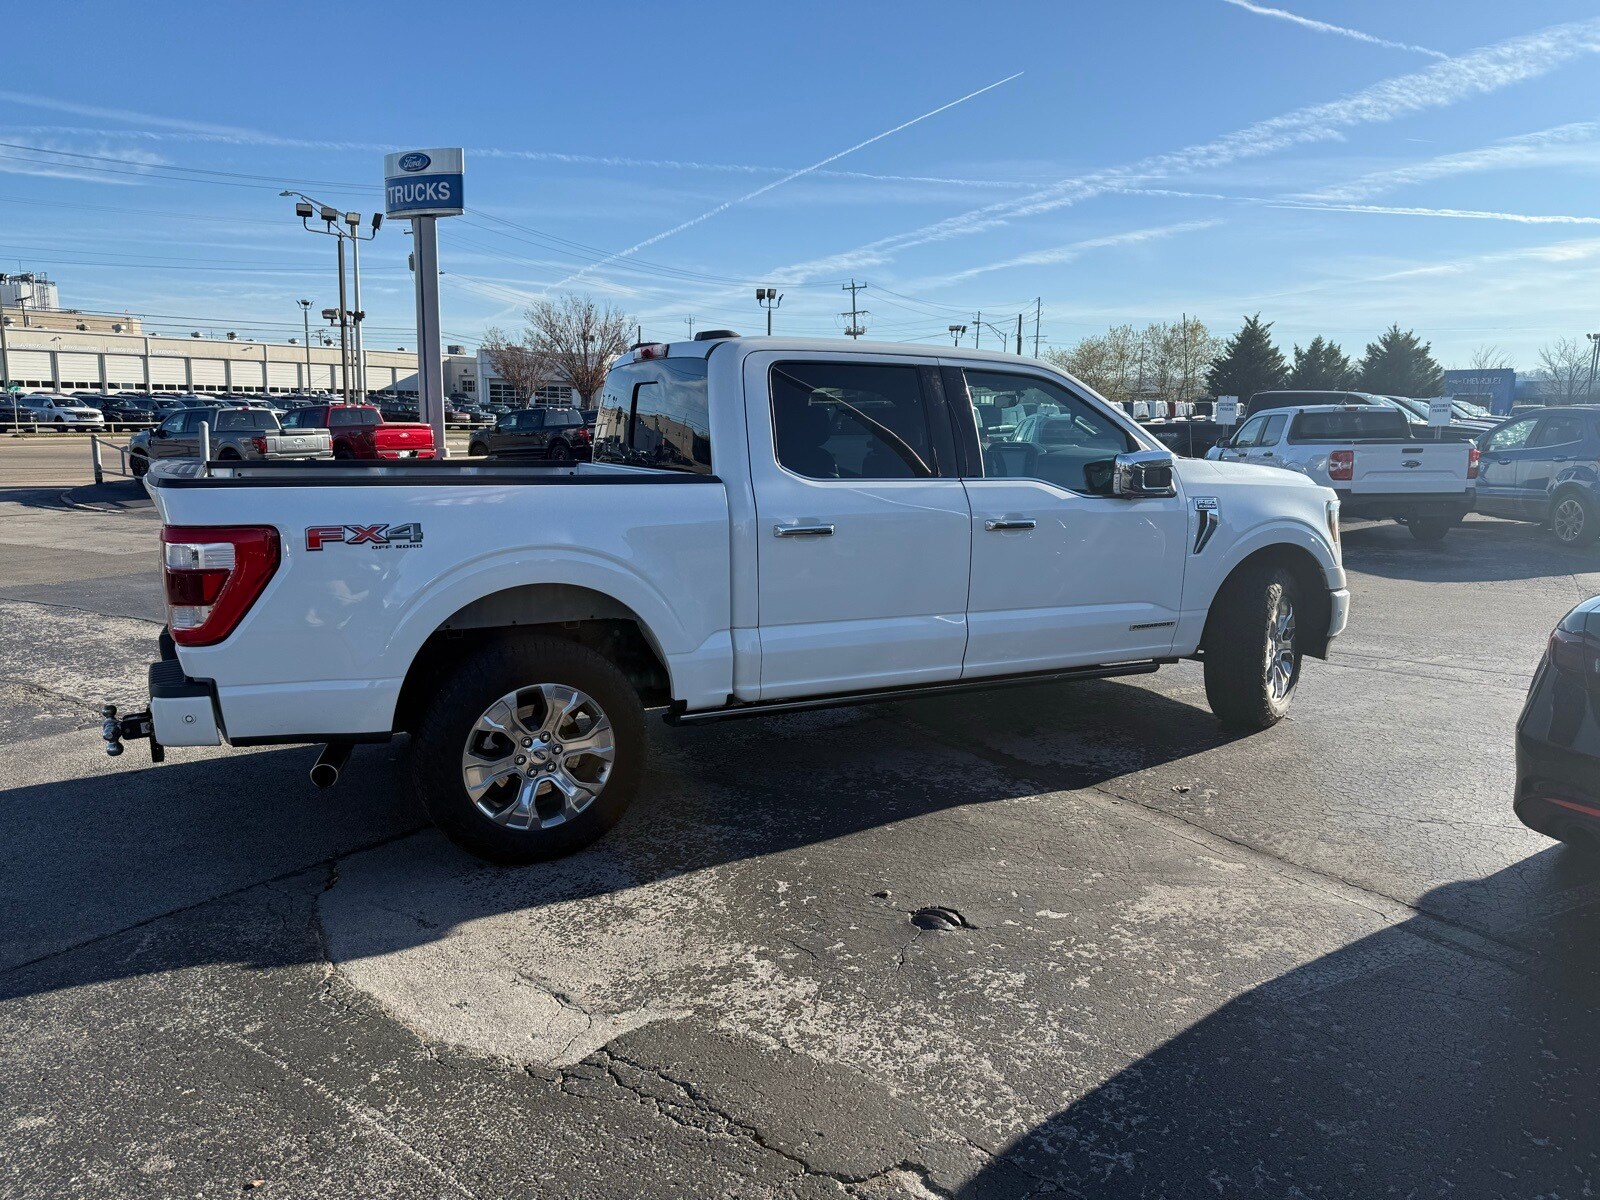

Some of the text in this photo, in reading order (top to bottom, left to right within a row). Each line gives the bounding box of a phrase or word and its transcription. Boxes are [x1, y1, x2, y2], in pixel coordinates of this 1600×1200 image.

[403, 155, 422, 168] Ford
[387, 181, 451, 204] TRUCKS
[1462, 377, 1503, 385] CHEVROLET
[304, 522, 424, 552] FX4
